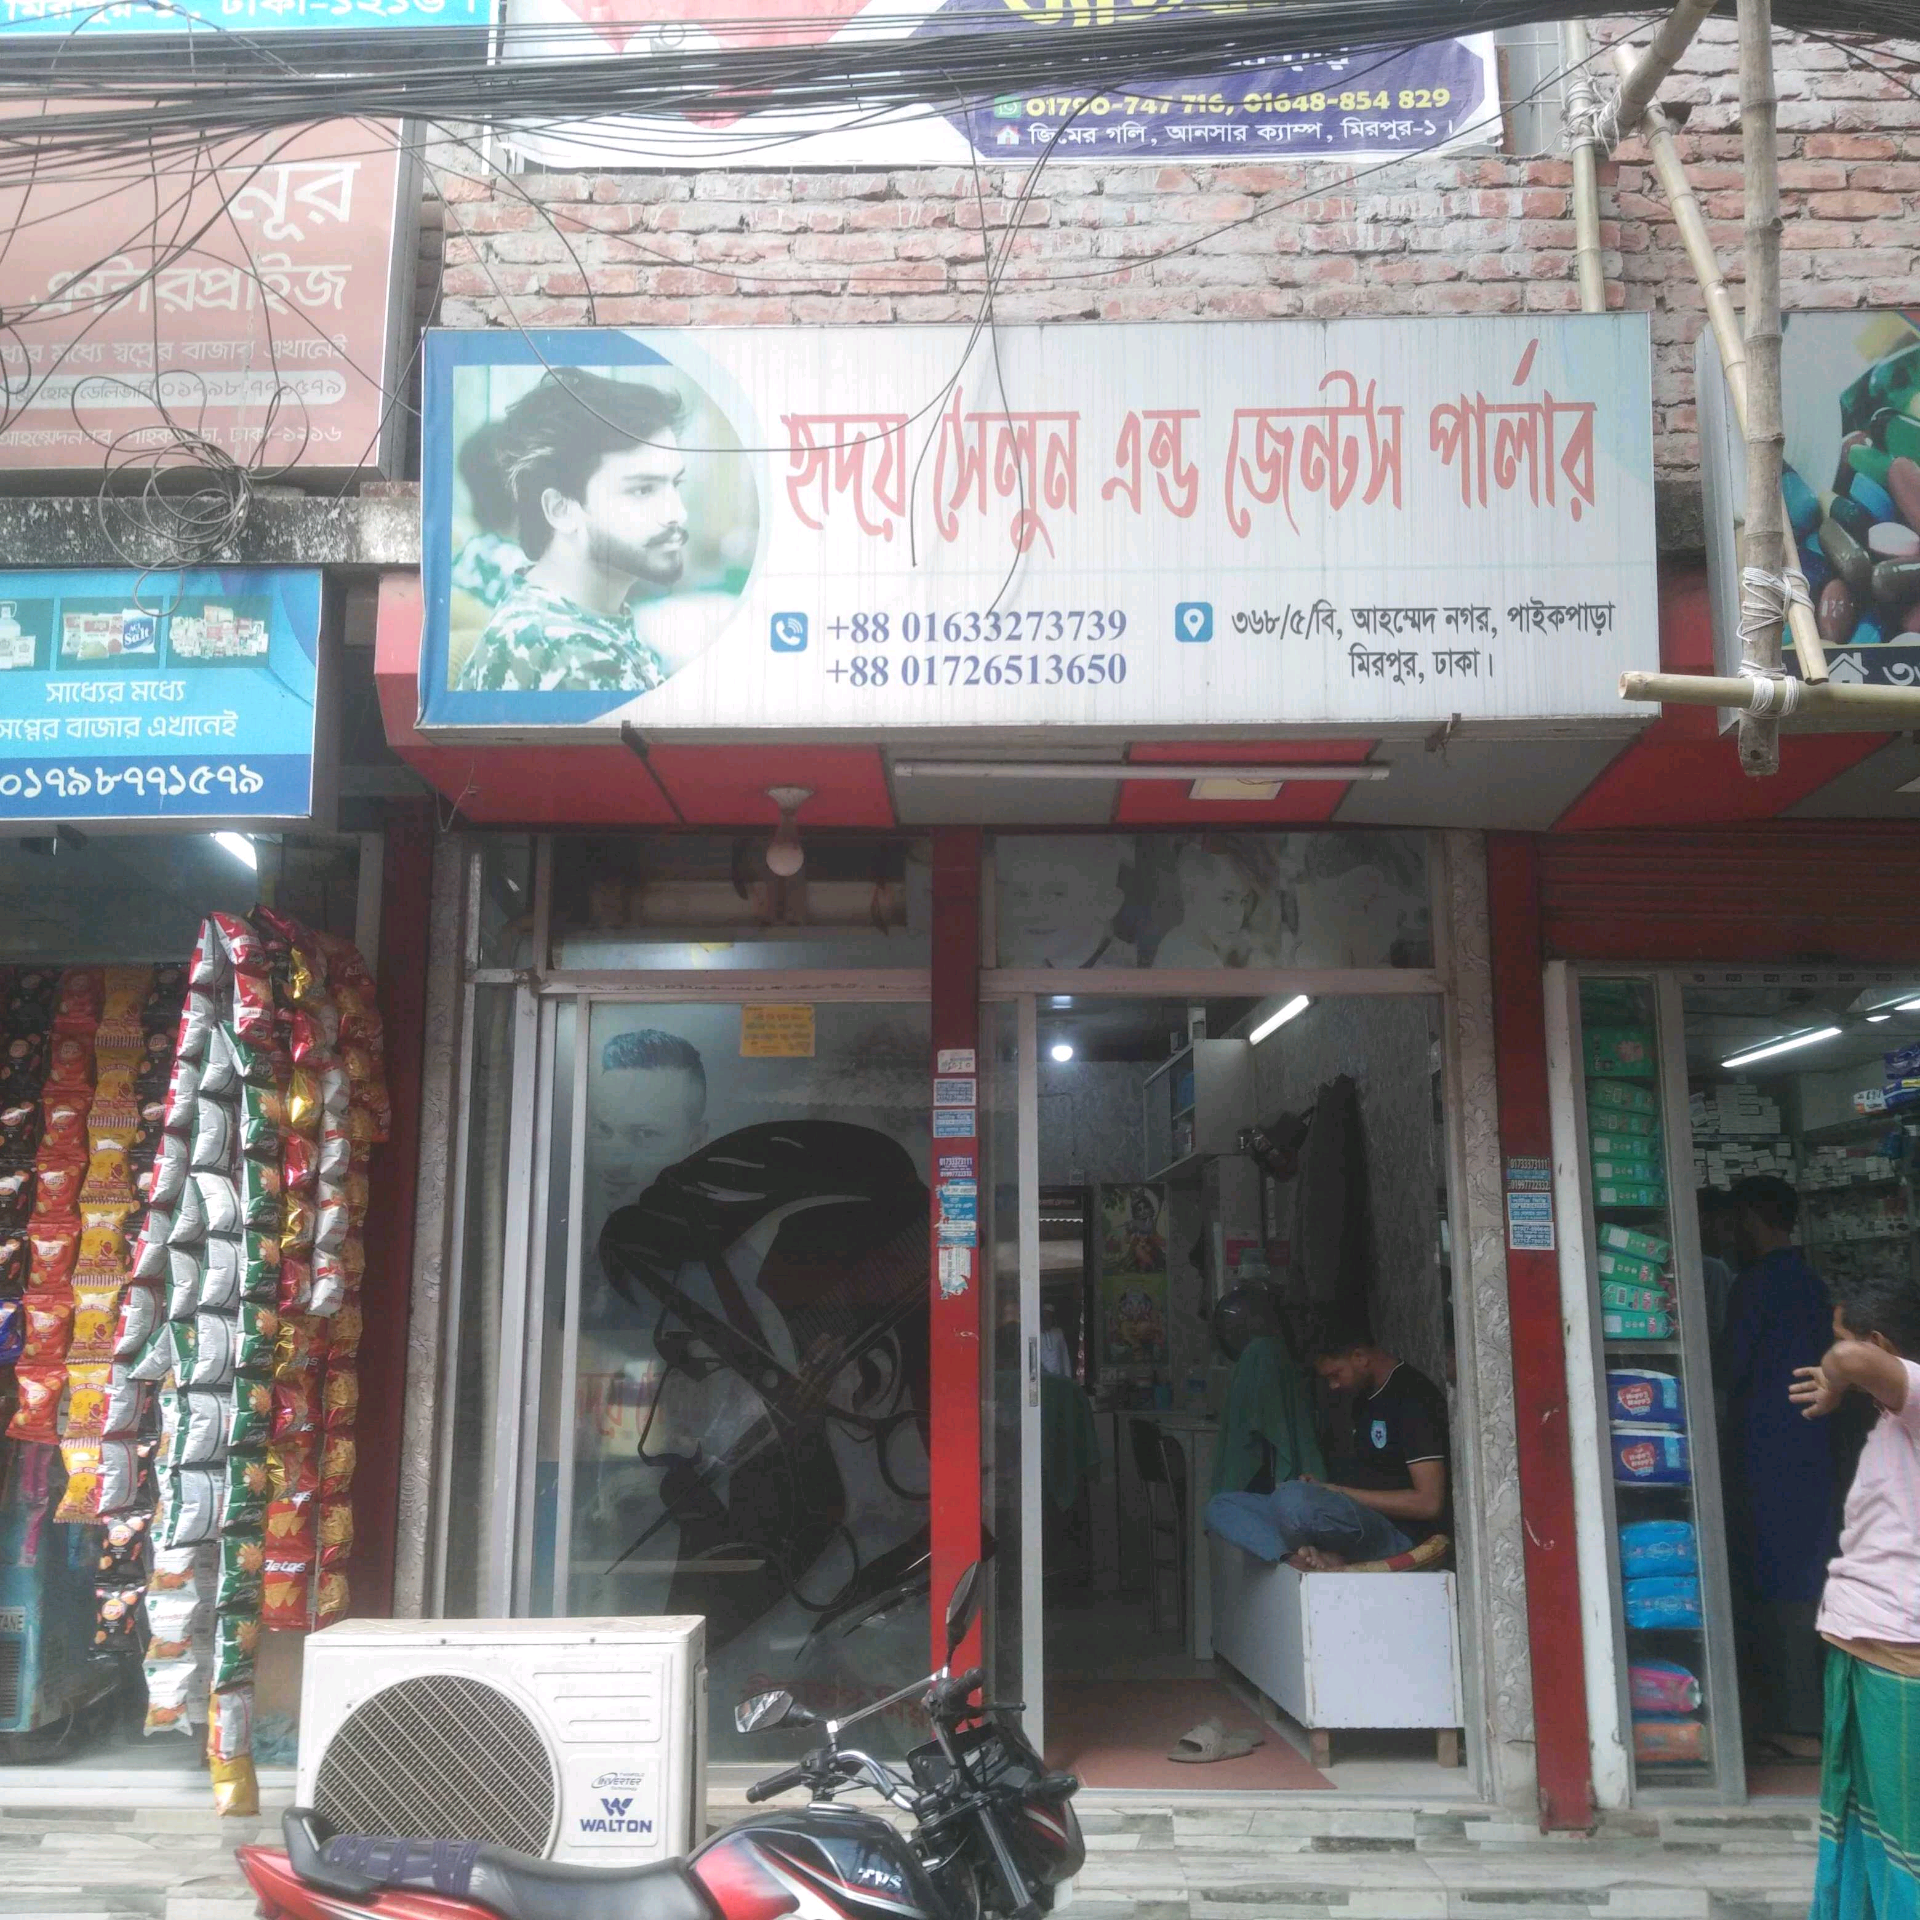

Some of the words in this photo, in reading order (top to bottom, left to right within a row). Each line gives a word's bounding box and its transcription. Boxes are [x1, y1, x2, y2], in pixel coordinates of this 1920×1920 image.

[1026, 95, 1173, 117] 01790-747
[1243, 90, 1390, 113] 01648-854
[1399, 88, 1450, 109] 829
[1164, 124, 1249, 143] আনসার
[225, 161, 361, 242] নূর
[30, 251, 353, 315] এন্টারপ্রাইজ
[262, 333, 348, 361] এখানেই
[780, 413, 909, 542] হৃদয়
[933, 385, 1081, 559] সেলুন
[1101, 410, 1201, 519] এন্ড
[1224, 369, 1404, 538] জেন্টস
[1429, 338, 1597, 523] পার্লার
[826, 612, 890, 643] +88
[902, 610, 1128, 643] 01633273739
[1350, 604, 1438, 637] আহম্মেদ
[1507, 596, 1616, 637] পাইকপাড়া
[124, 627, 150, 646] Salt
[825, 655, 890, 686] +88
[901, 653, 1128, 686] 01726513650
[46, 680, 125, 704] সাধ্যের
[131, 679, 187, 702] মধ্যে
[65, 716, 142, 739] বাজার
[148, 709, 239, 738] এখানেই
[0, 763, 264, 798] ০১৭৯৮৭৭১৫৭৯
[579, 1818, 652, 1833] WALTON
